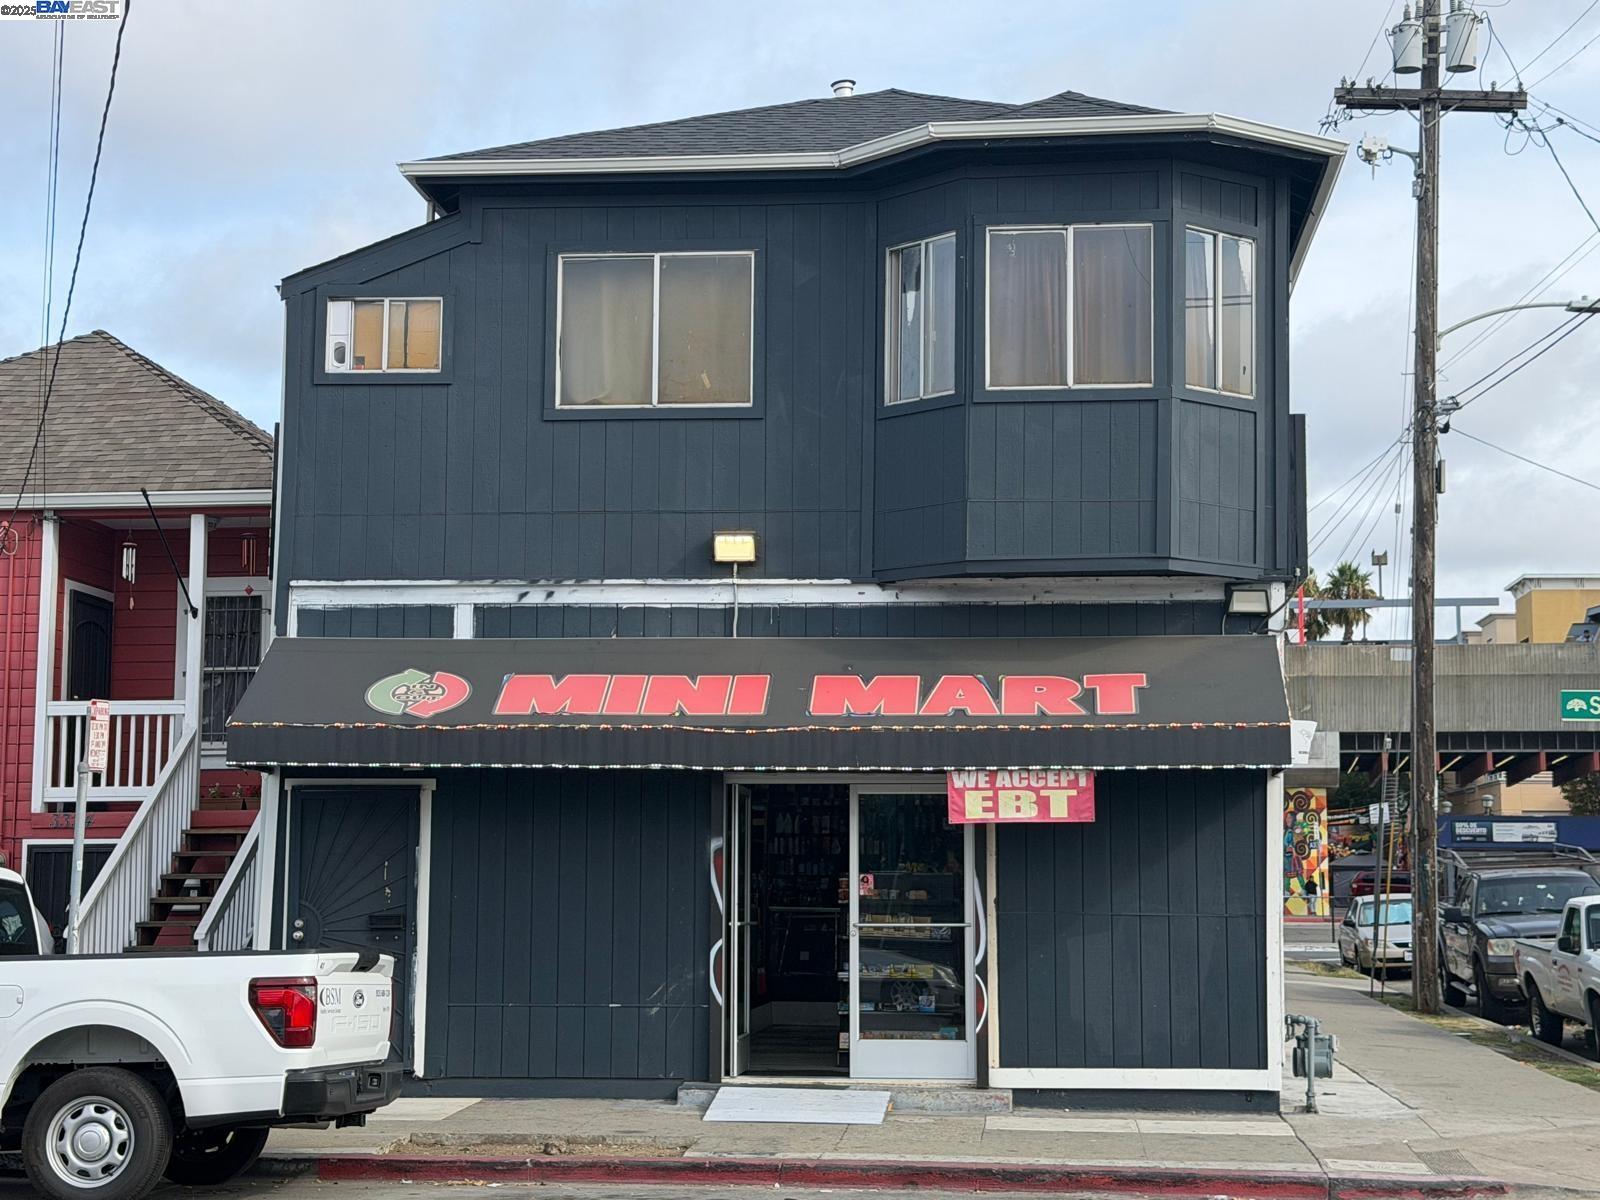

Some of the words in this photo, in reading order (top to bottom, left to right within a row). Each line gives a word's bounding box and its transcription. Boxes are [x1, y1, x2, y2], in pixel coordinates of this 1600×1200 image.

[493, 673, 772, 716] MINI
[808, 673, 1148, 716] MART
[951, 770, 991, 788] WE
[995, 769, 1089, 788] ACCEPT
[965, 789, 1078, 819] EBT
